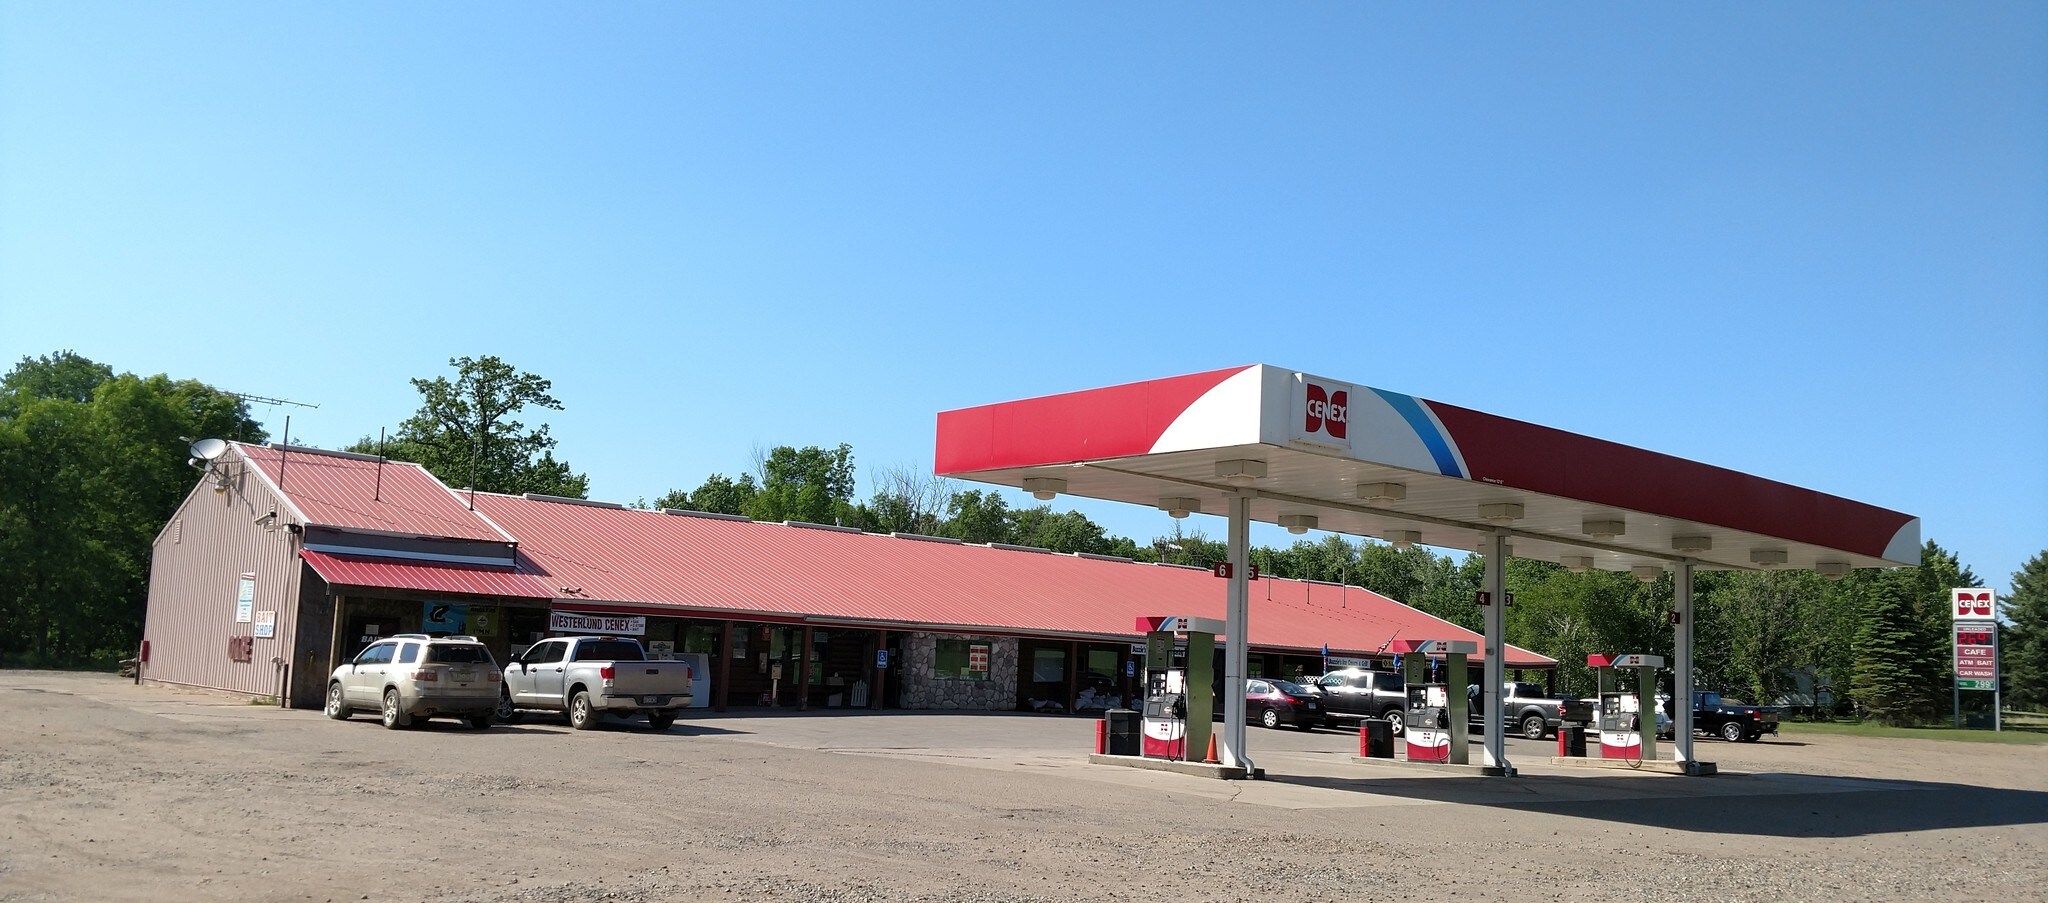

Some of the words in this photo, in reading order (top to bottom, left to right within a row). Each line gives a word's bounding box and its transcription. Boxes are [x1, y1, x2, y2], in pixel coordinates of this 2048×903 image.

[1307, 399, 1346, 423] CENEX
[1219, 564, 1226, 577] 6
[1248, 566, 1254, 578] 5
[1480, 593, 1485, 604] 4
[1505, 594, 1510, 605] 3
[1958, 600, 1990, 608] CENEX
[256, 612, 274, 623] BAIT
[552, 615, 602, 630] WESTERLUND
[605, 618, 630, 631] CENEX
[1671, 614, 1675, 622] 2
[255, 624, 272, 636] SHOP
